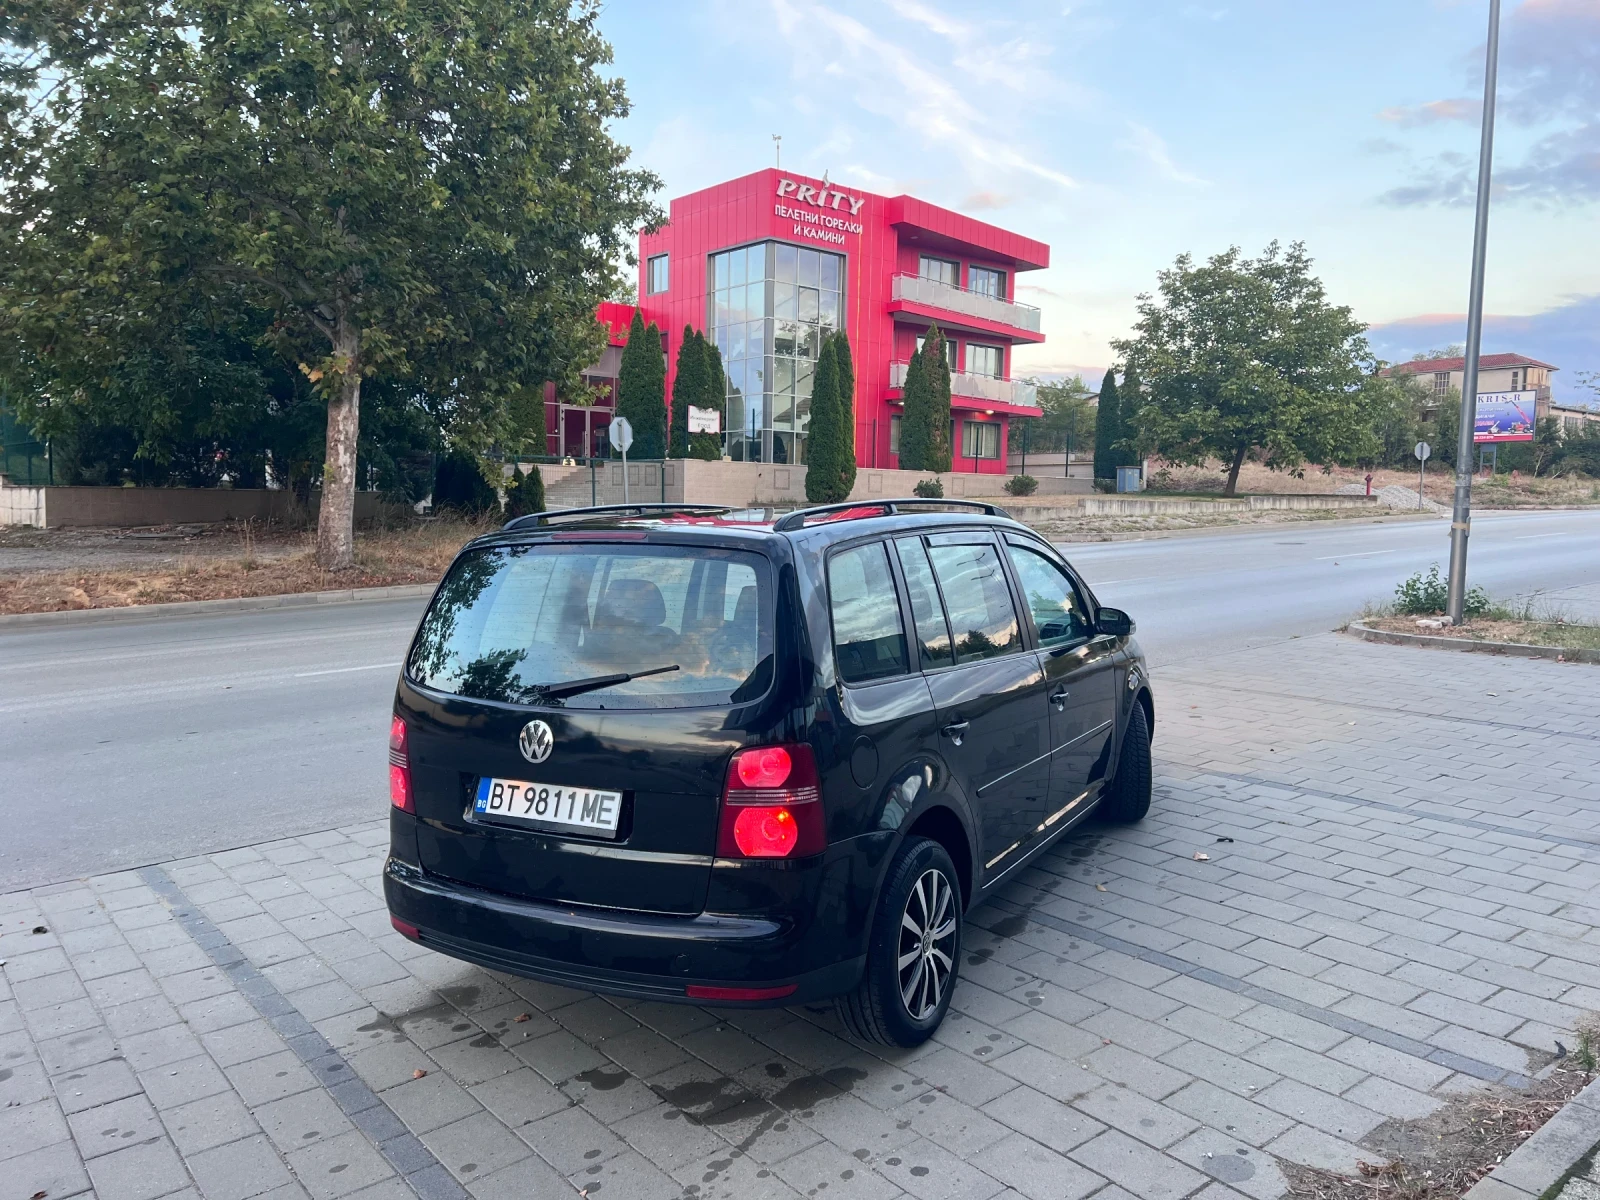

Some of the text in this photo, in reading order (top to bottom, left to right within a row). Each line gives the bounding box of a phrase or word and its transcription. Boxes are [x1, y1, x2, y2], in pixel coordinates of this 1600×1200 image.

[776, 171, 865, 215] PRITY
[775, 205, 863, 234] ПЕЛЕТНИ ГОРЕЛКИ
[793, 224, 845, 245] И КАМИНИ
[520, 720, 553, 763] VW
[477, 799, 487, 808] BG
